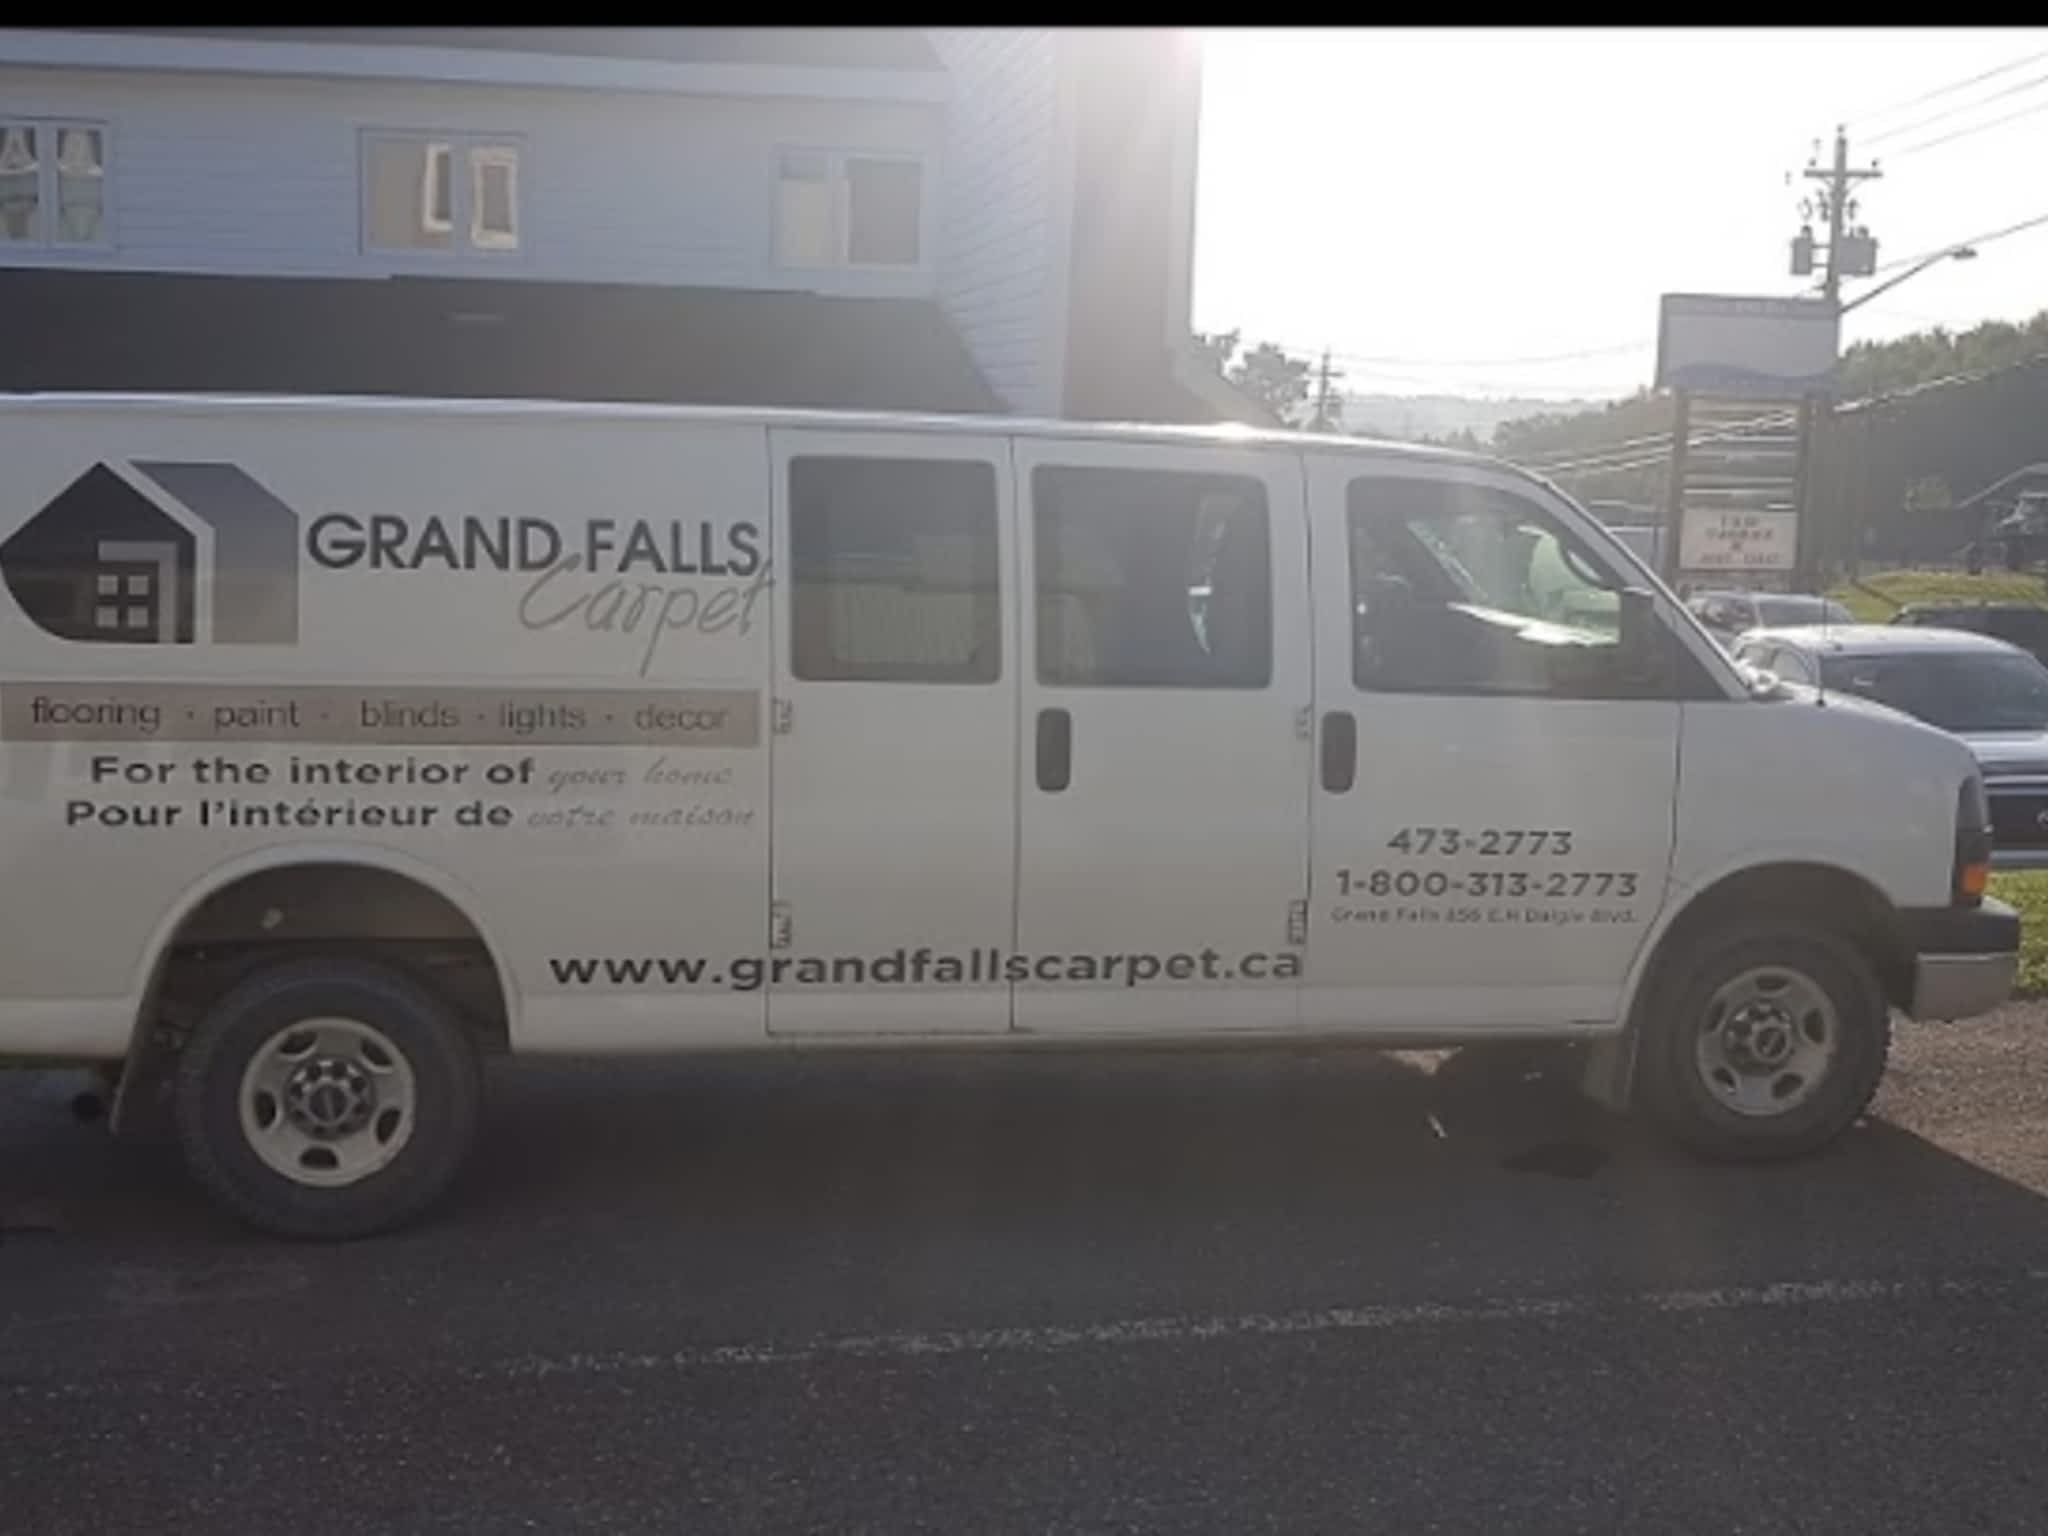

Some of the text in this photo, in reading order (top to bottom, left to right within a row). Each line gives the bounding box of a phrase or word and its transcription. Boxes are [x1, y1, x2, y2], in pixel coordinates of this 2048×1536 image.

[306, 513, 761, 576] GRAND FALLS
[518, 553, 774, 678] Carpet
[31, 696, 728, 734] flooring paint blinds lights decor
[91, 756, 175, 784] For
[192, 757, 271, 784] the
[289, 757, 469, 785] interior
[486, 756, 535, 785] of
[66, 800, 182, 827] Pour
[455, 800, 514, 827] de
[1386, 828, 1573, 856] 473-2773
[1336, 869, 1639, 897] 1-800-313-2773
[549, 947, 1303, 991] www.grandfallscarpet.ca
